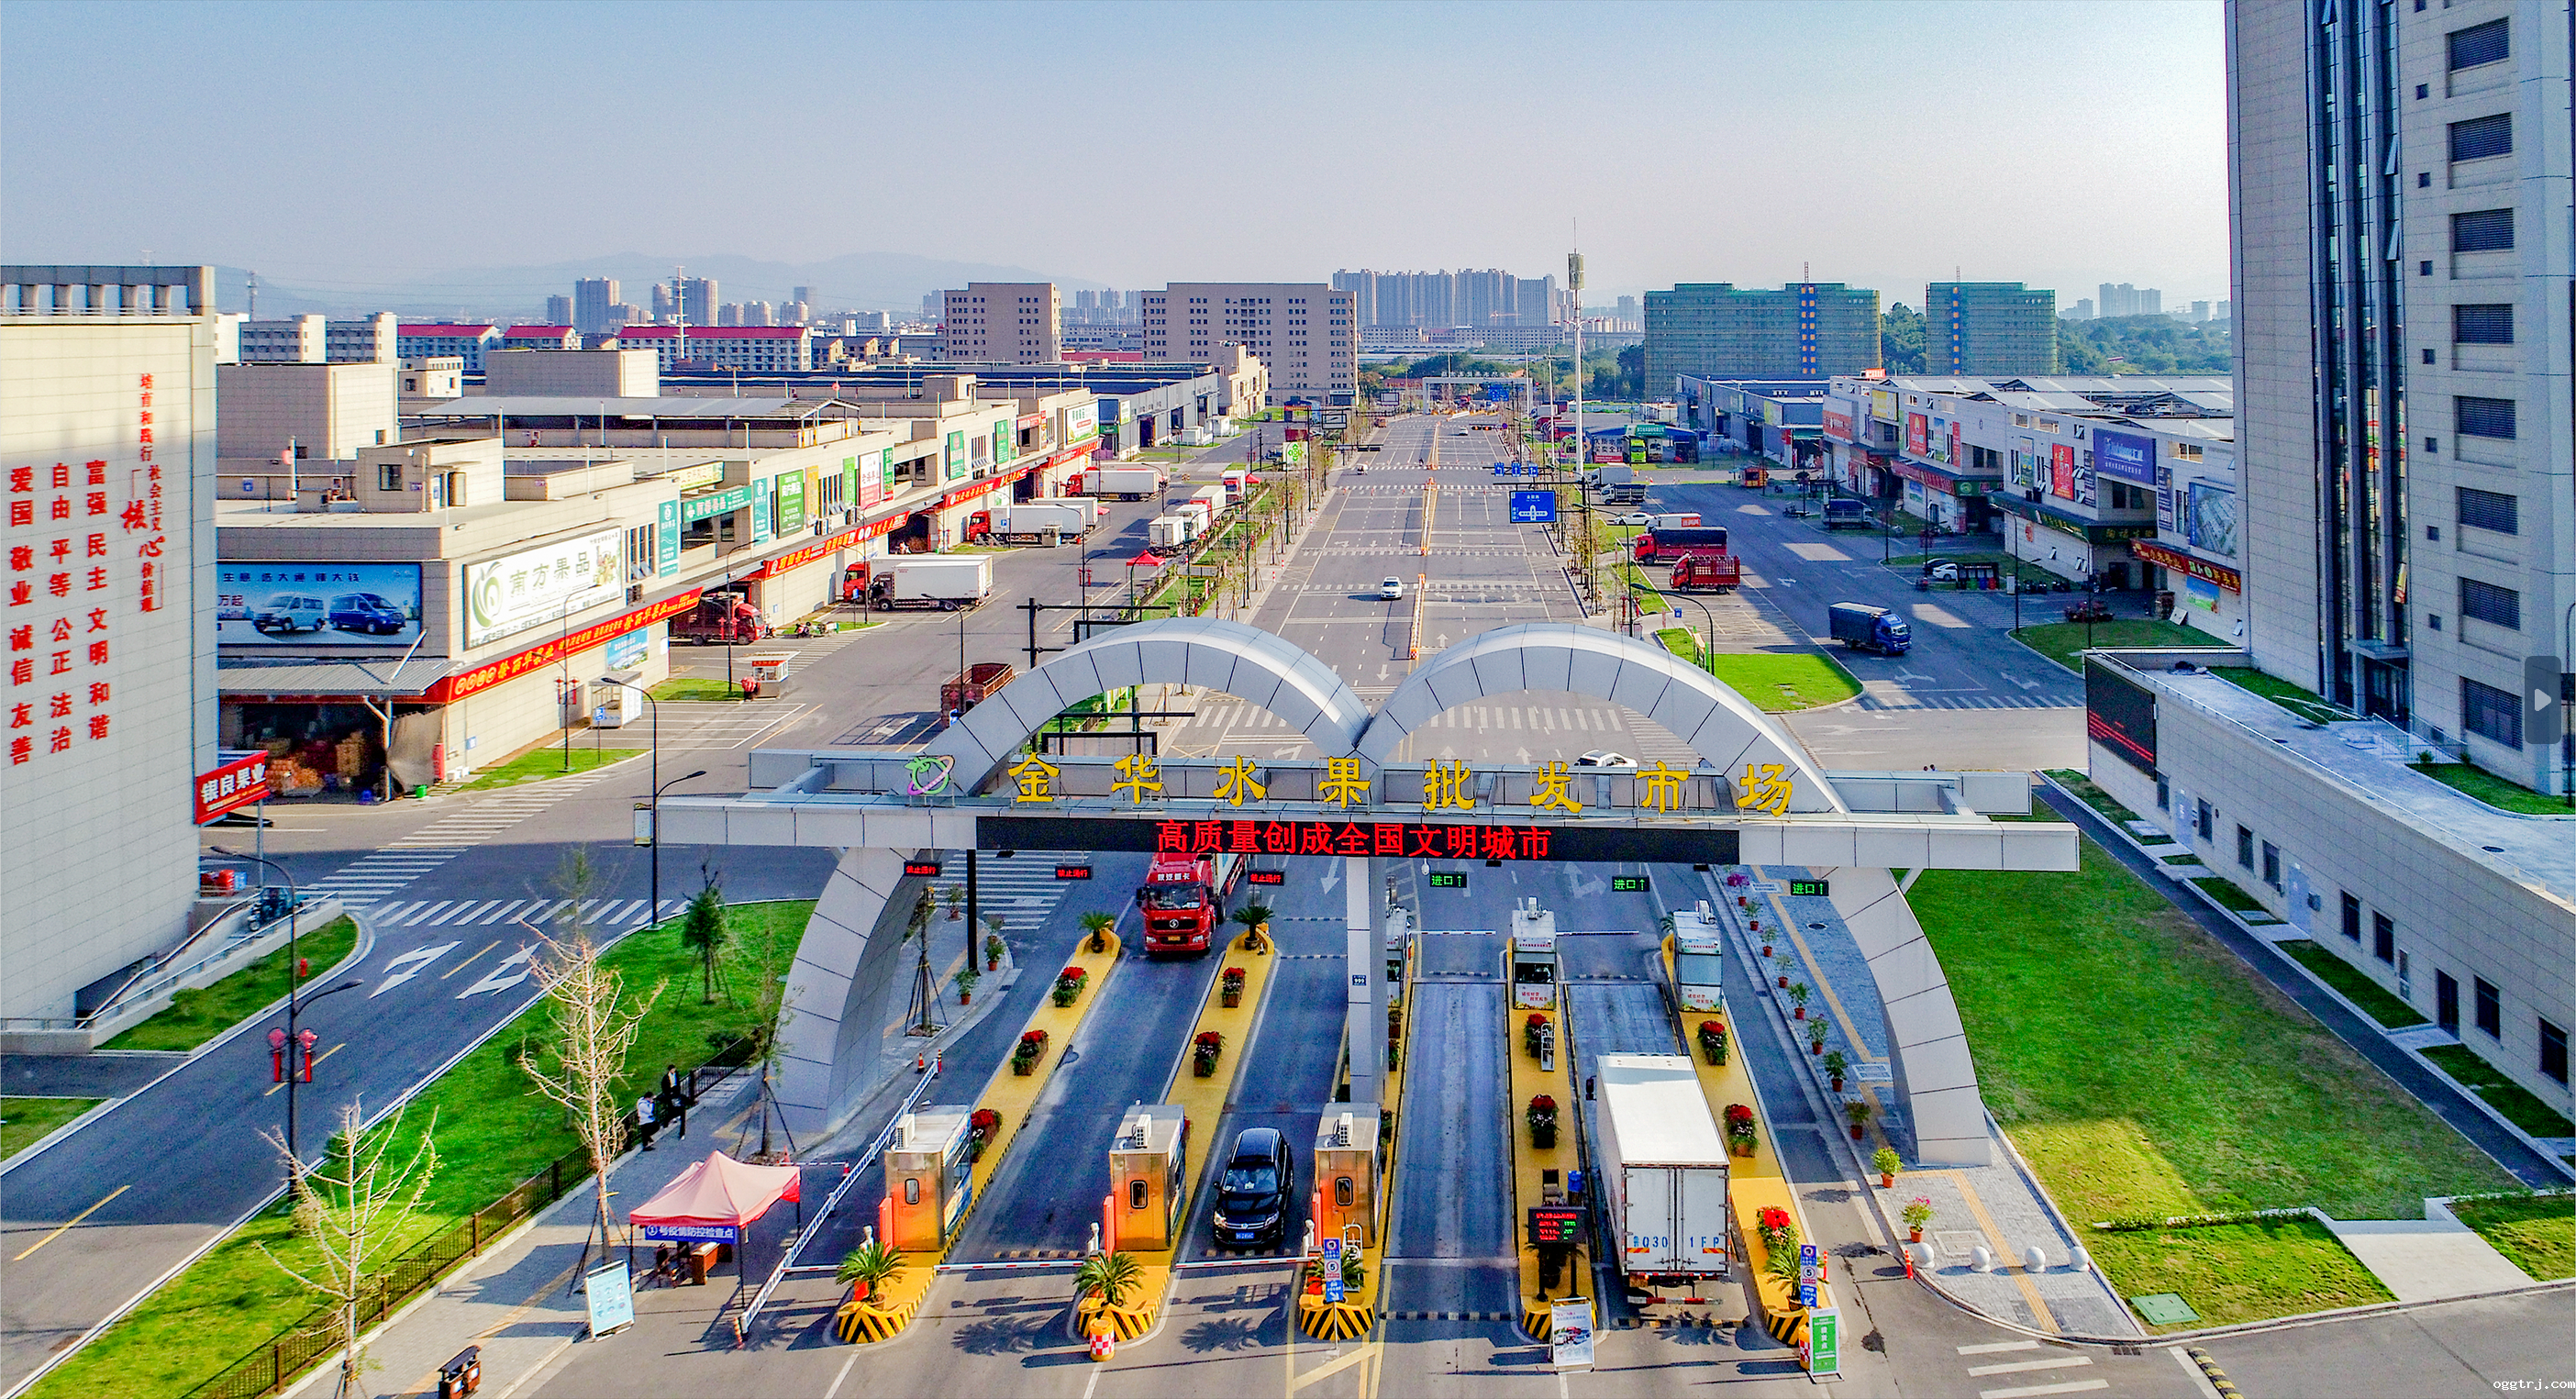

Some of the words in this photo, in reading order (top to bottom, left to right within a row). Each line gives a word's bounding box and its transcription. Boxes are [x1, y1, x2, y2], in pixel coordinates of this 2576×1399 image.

[139, 373, 154, 461] 培育和践行
[147, 465, 161, 531] 社会主义
[509, 551, 590, 594] 南方果品
[201, 763, 266, 804] 银良果业
[1008, 751, 1793, 816] 金华水果批发市场
[1155, 818, 1552, 860] 高质量创成全国文明城市
[1431, 875, 1454, 886] 进口
[1614, 879, 1637, 890] 进口
[1792, 883, 1815, 894] 进口
